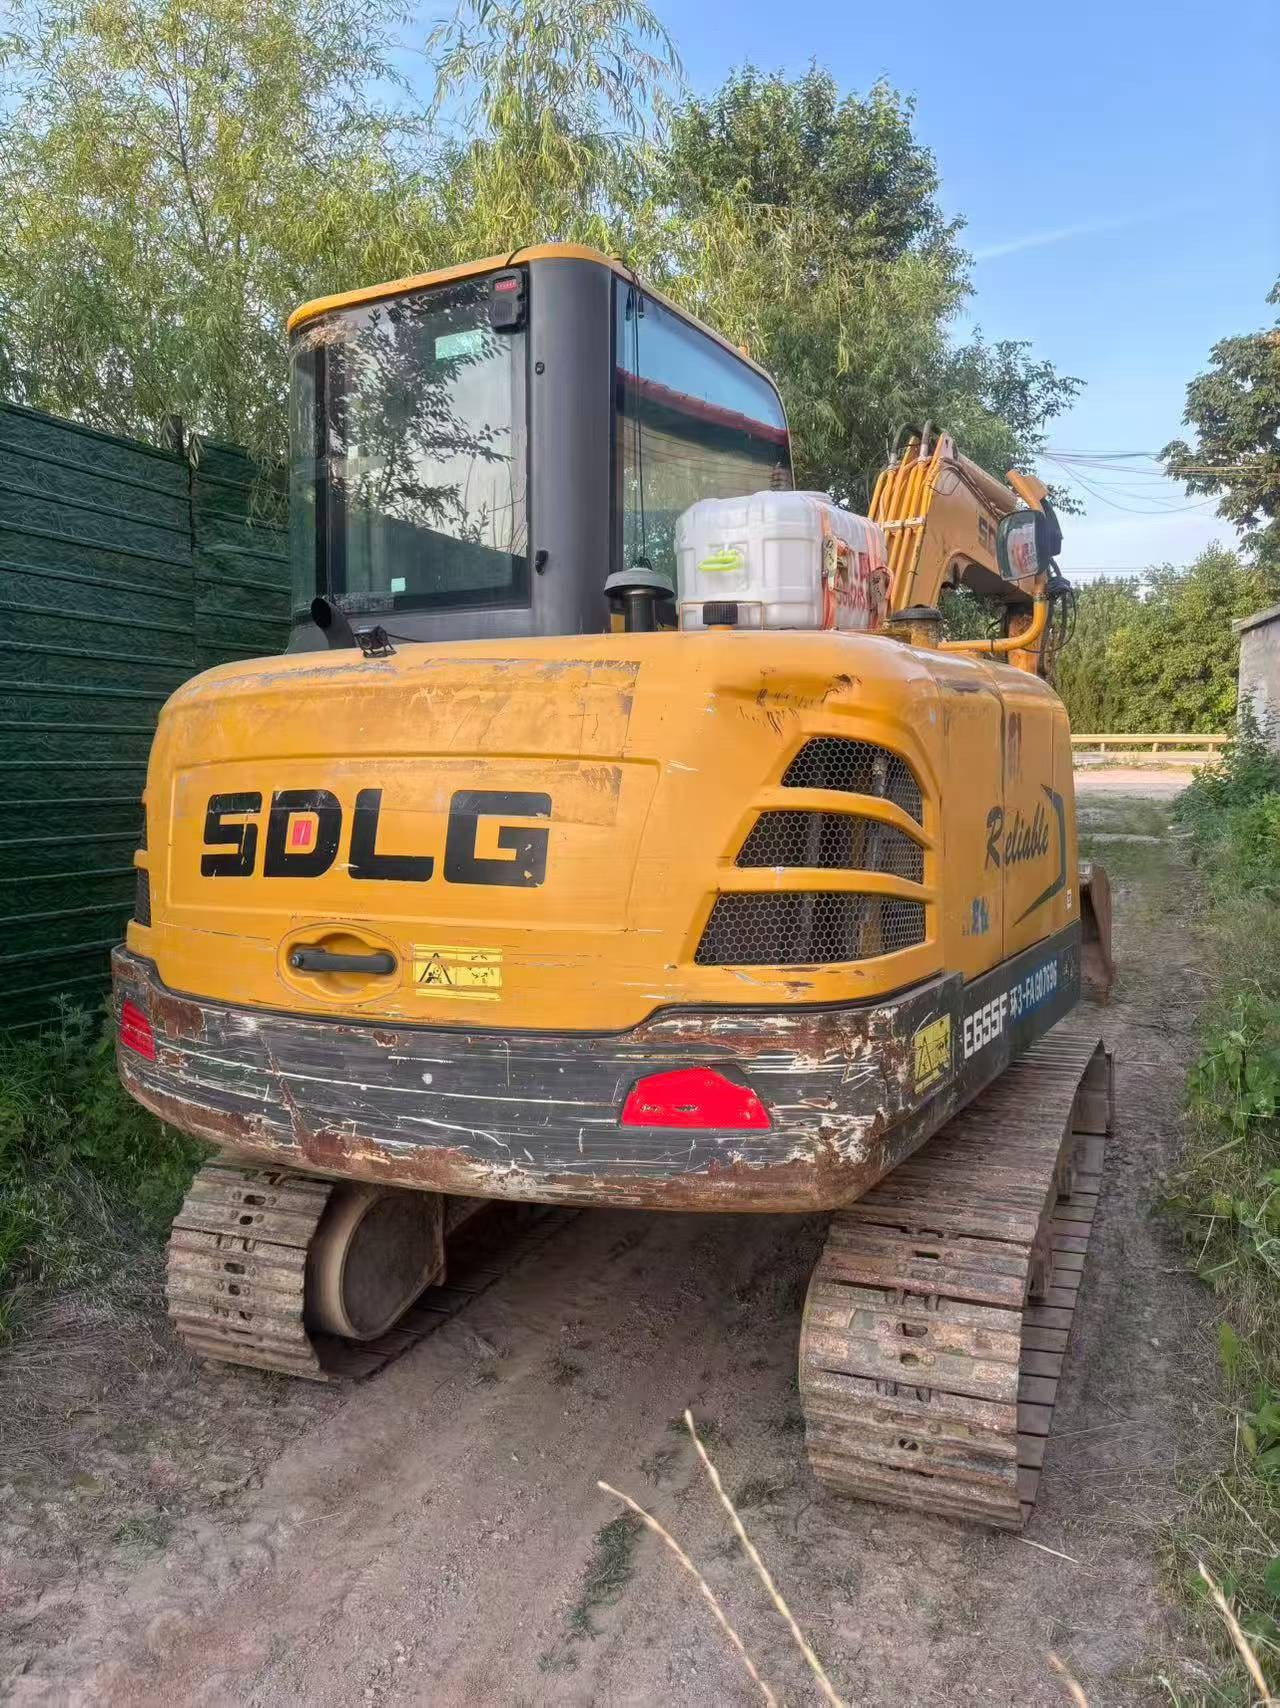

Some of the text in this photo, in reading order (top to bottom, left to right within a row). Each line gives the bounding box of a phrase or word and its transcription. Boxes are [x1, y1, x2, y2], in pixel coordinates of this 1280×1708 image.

[200, 788, 553, 888] SDLG
[985, 801, 1049, 871] Reliable
[964, 992, 1008, 1060] E655F
